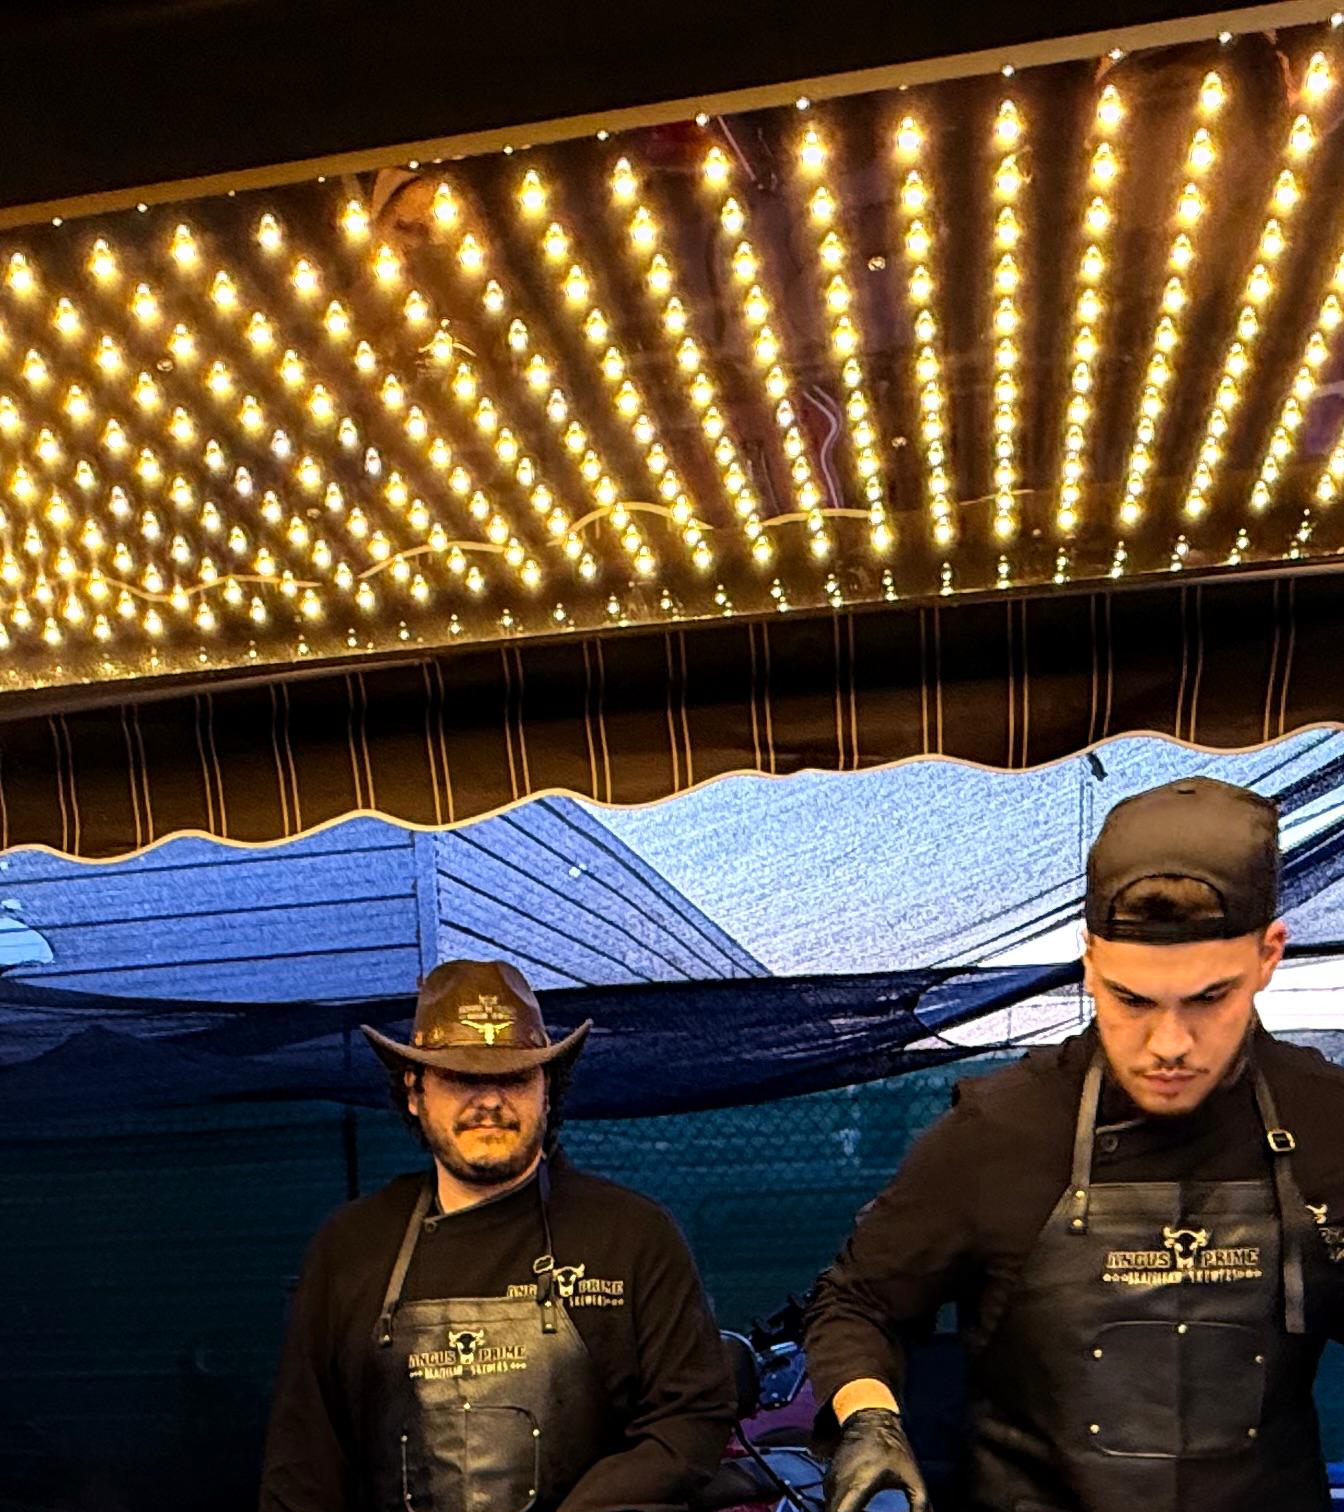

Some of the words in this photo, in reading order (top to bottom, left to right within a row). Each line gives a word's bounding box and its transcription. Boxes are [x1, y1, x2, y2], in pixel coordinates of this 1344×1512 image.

[1106, 1251, 1170, 1269] ANGUS
[1201, 1247, 1259, 1267] PRIME
[578, 1279, 624, 1295] PRIME
[408, 1351, 456, 1369] ANGUS
[479, 1346, 527, 1362] PRIME
